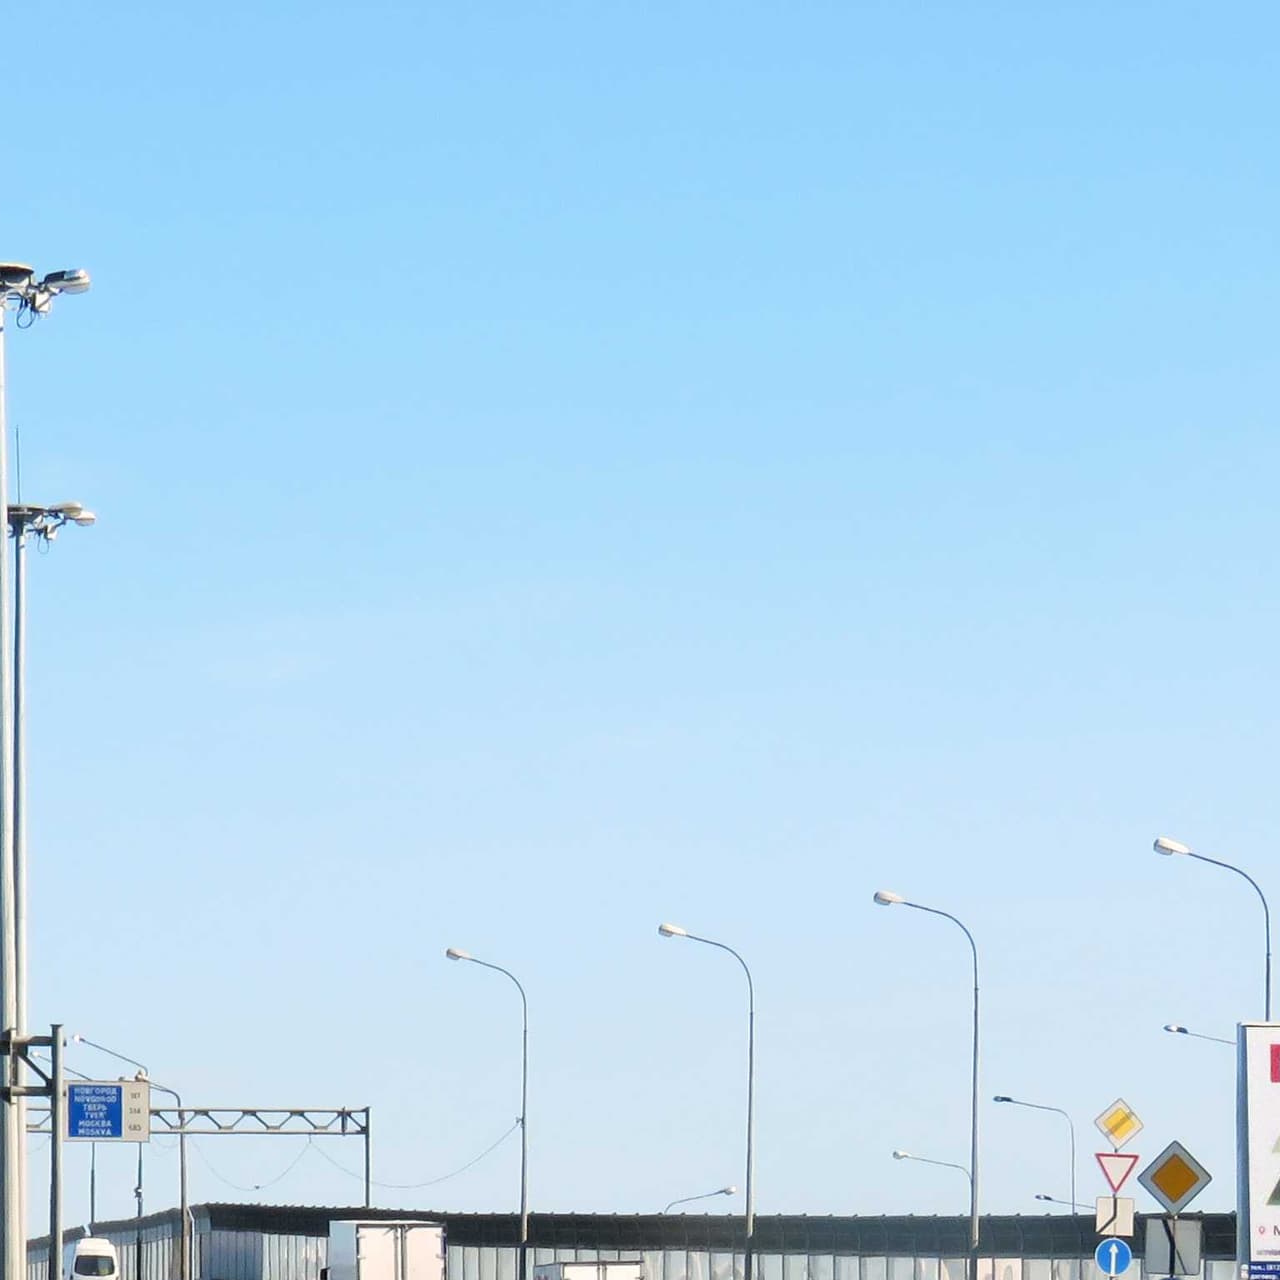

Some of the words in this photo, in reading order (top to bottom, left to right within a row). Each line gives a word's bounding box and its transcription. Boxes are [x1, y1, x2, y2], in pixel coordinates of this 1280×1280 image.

[73, 1087, 118, 1096] НОВГОРОД
[83, 1104, 108, 1112] ТВЕРЬ
[78, 1119, 113, 1127] МОСКВА
[78, 1127, 113, 1136] MOSKVA
